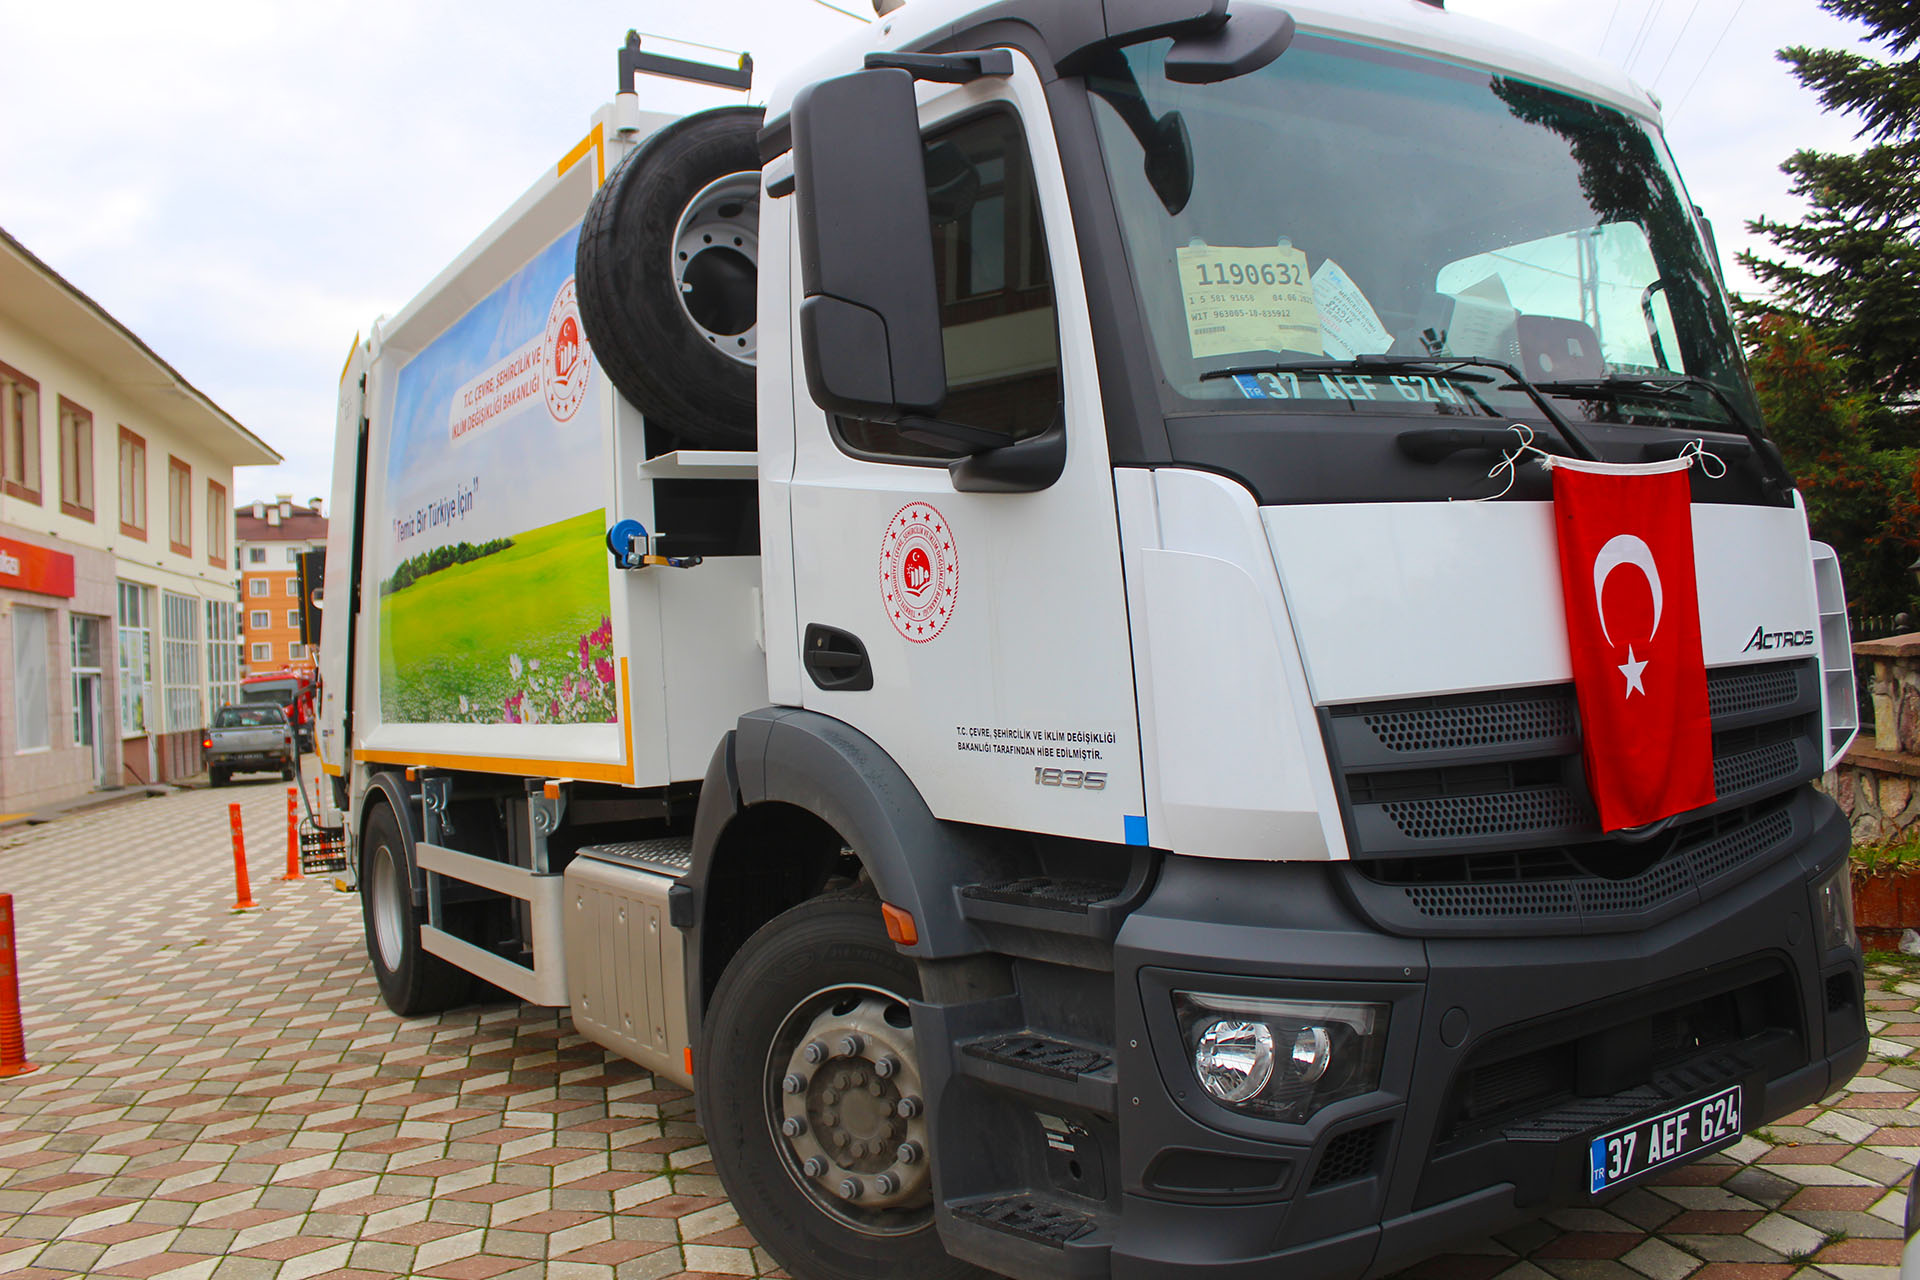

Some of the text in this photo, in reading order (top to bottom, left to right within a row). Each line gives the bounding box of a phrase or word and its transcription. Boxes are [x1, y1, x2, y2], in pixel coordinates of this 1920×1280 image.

[1196, 263, 1303, 286] 1190632
[531, 346, 541, 366] VE
[503, 373, 540, 410] BAKANLIĞI
[1246, 387, 1262, 398] TR
[1256, 372, 1301, 399] 37
[1318, 374, 1377, 400] AEF
[416, 508, 426, 534] Bir
[428, 497, 455, 528] Türkiye
[956, 727, 1116, 744] T.C. ÇEVRE, ŞEHİRCİLİK VE İKLİM DEĞİŞİKLİĞİ
[957, 742, 1103, 762] BAKANLIĞI TARAFINDAN HİBE EDİLMİŞTİR.
[1034, 766, 1108, 791] 1835
[1593, 1094, 1738, 1181] TR 37 AEF 624
